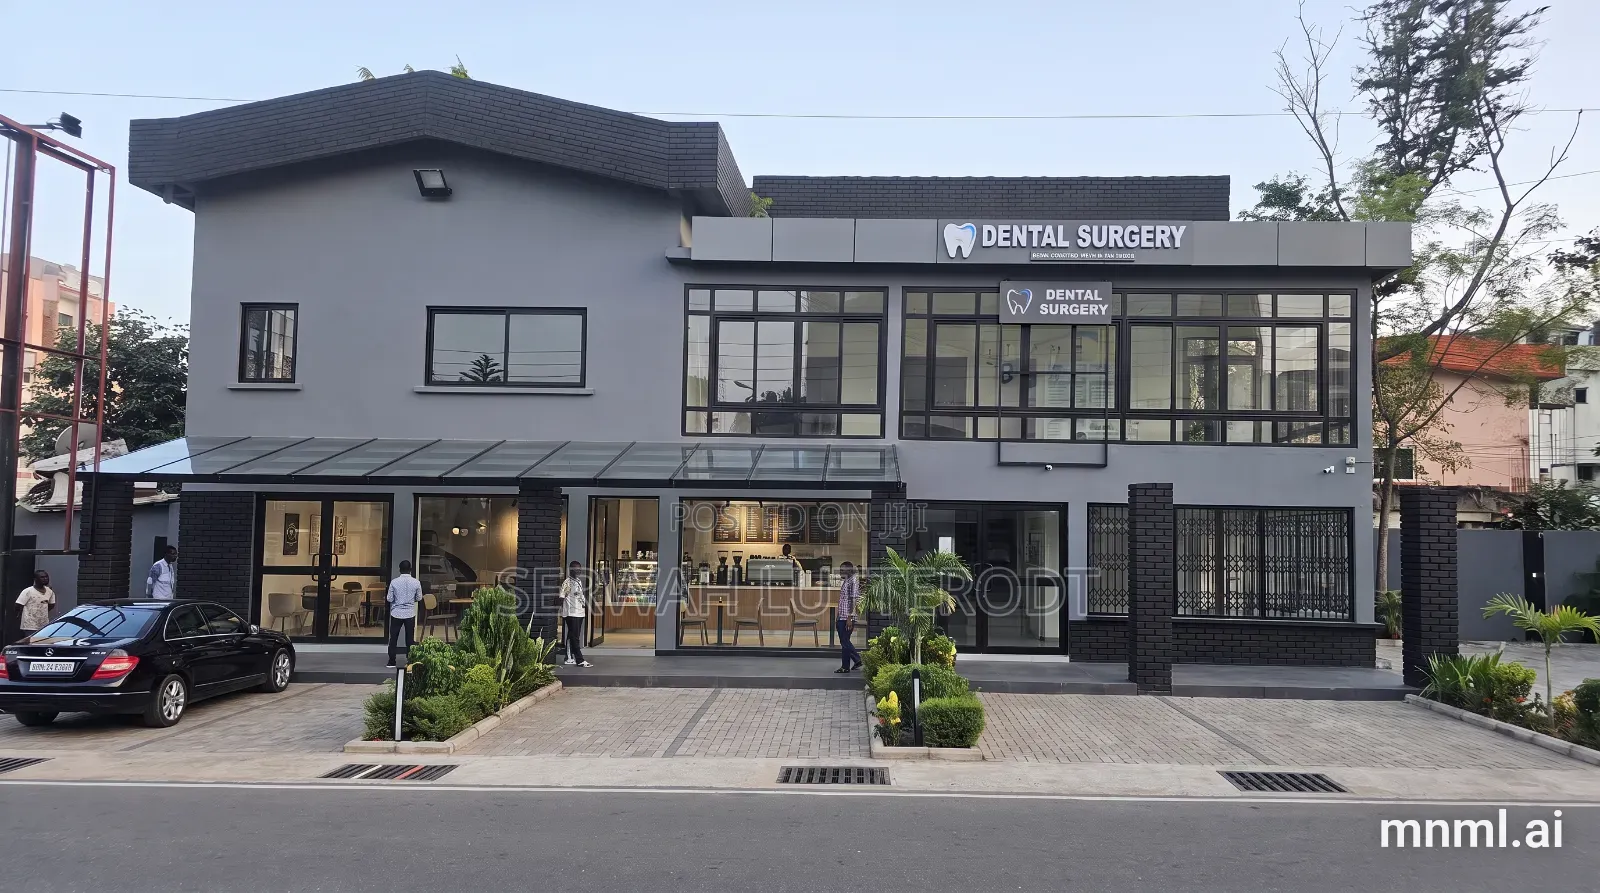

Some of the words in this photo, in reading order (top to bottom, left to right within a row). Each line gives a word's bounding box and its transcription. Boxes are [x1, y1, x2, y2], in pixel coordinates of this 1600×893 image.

[982, 224, 1070, 248] DENTAL
[1077, 224, 1187, 249] SURGERY
[1045, 289, 1103, 301] DENTAL
[1039, 303, 1109, 316] SURGERY
